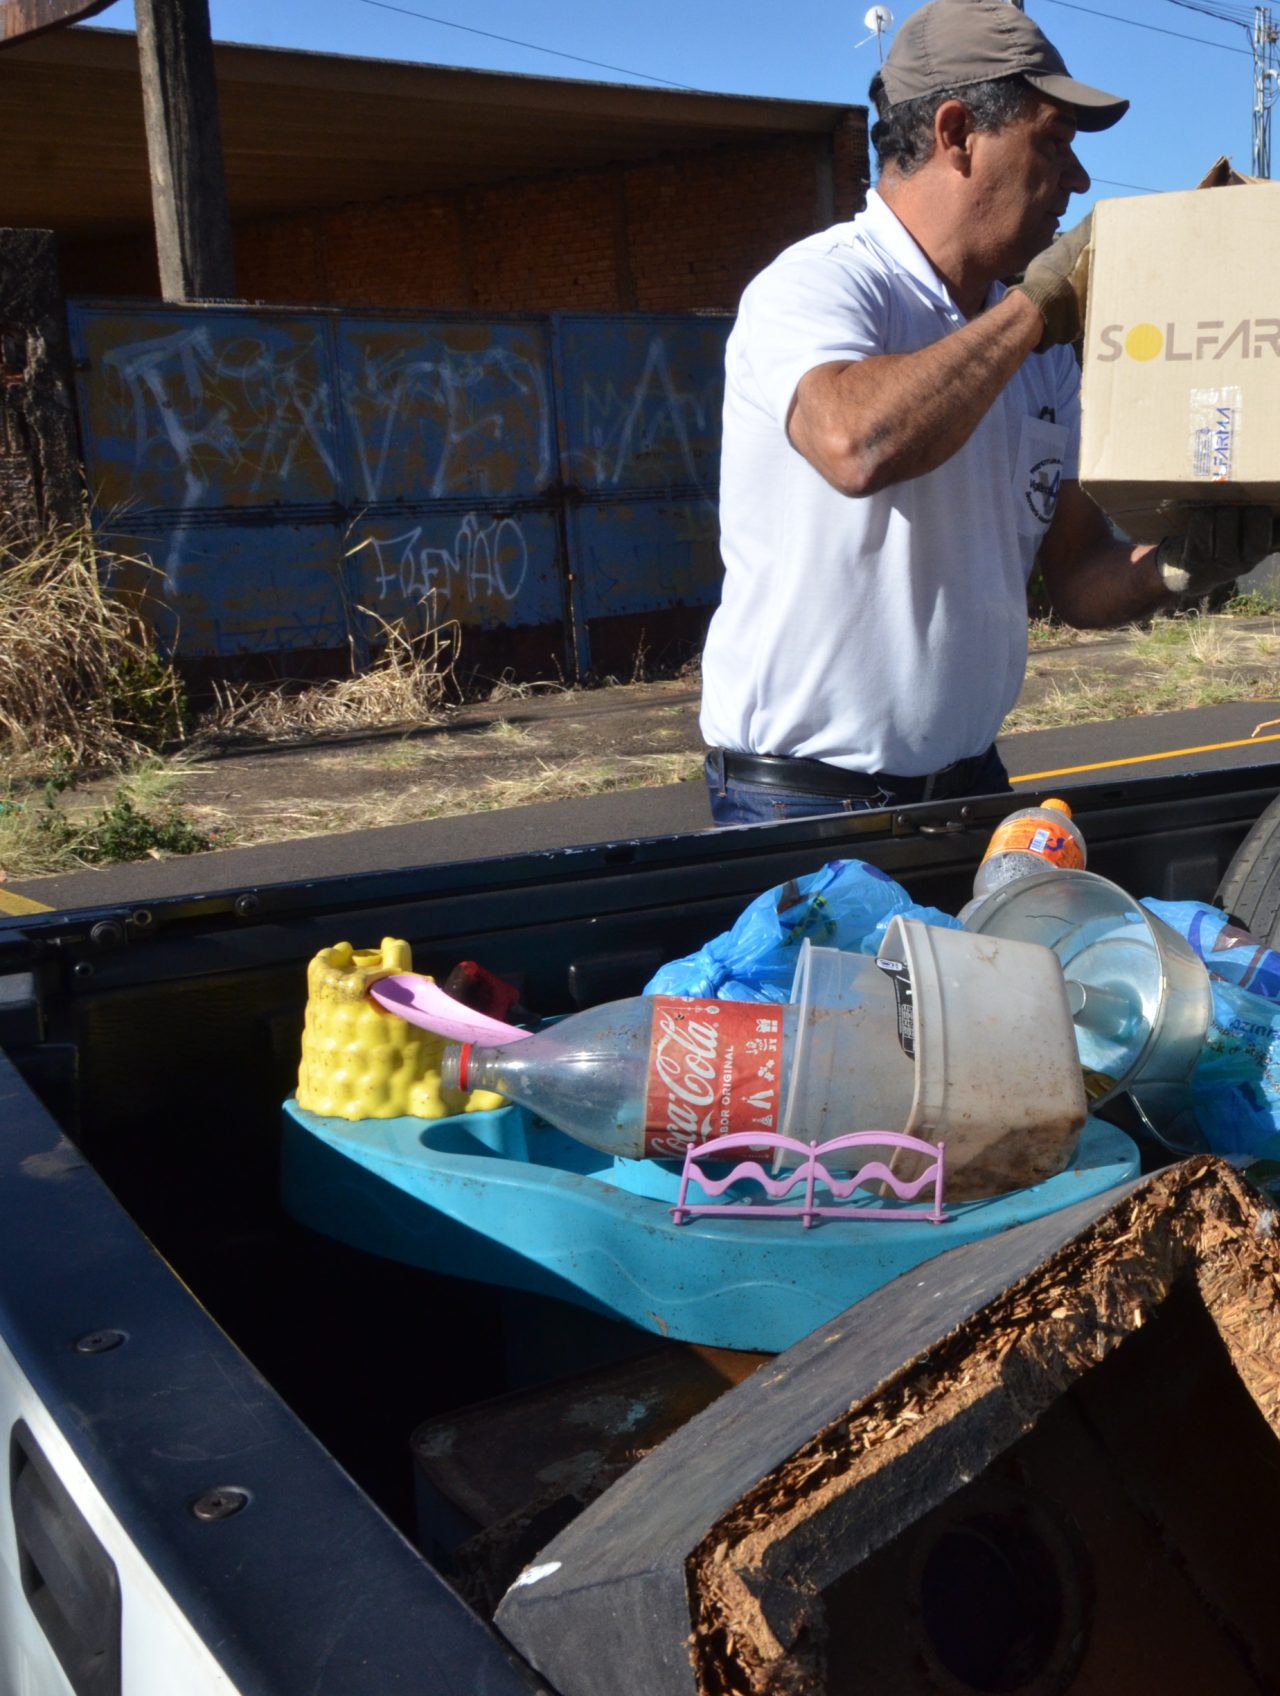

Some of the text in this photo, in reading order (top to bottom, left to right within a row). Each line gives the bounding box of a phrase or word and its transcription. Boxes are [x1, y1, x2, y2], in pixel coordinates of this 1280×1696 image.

[651, 1011, 719, 1157] Coca-Cola
[721, 1045, 734, 1105] ORIGINAL
[719, 1109, 730, 1136] BOR
